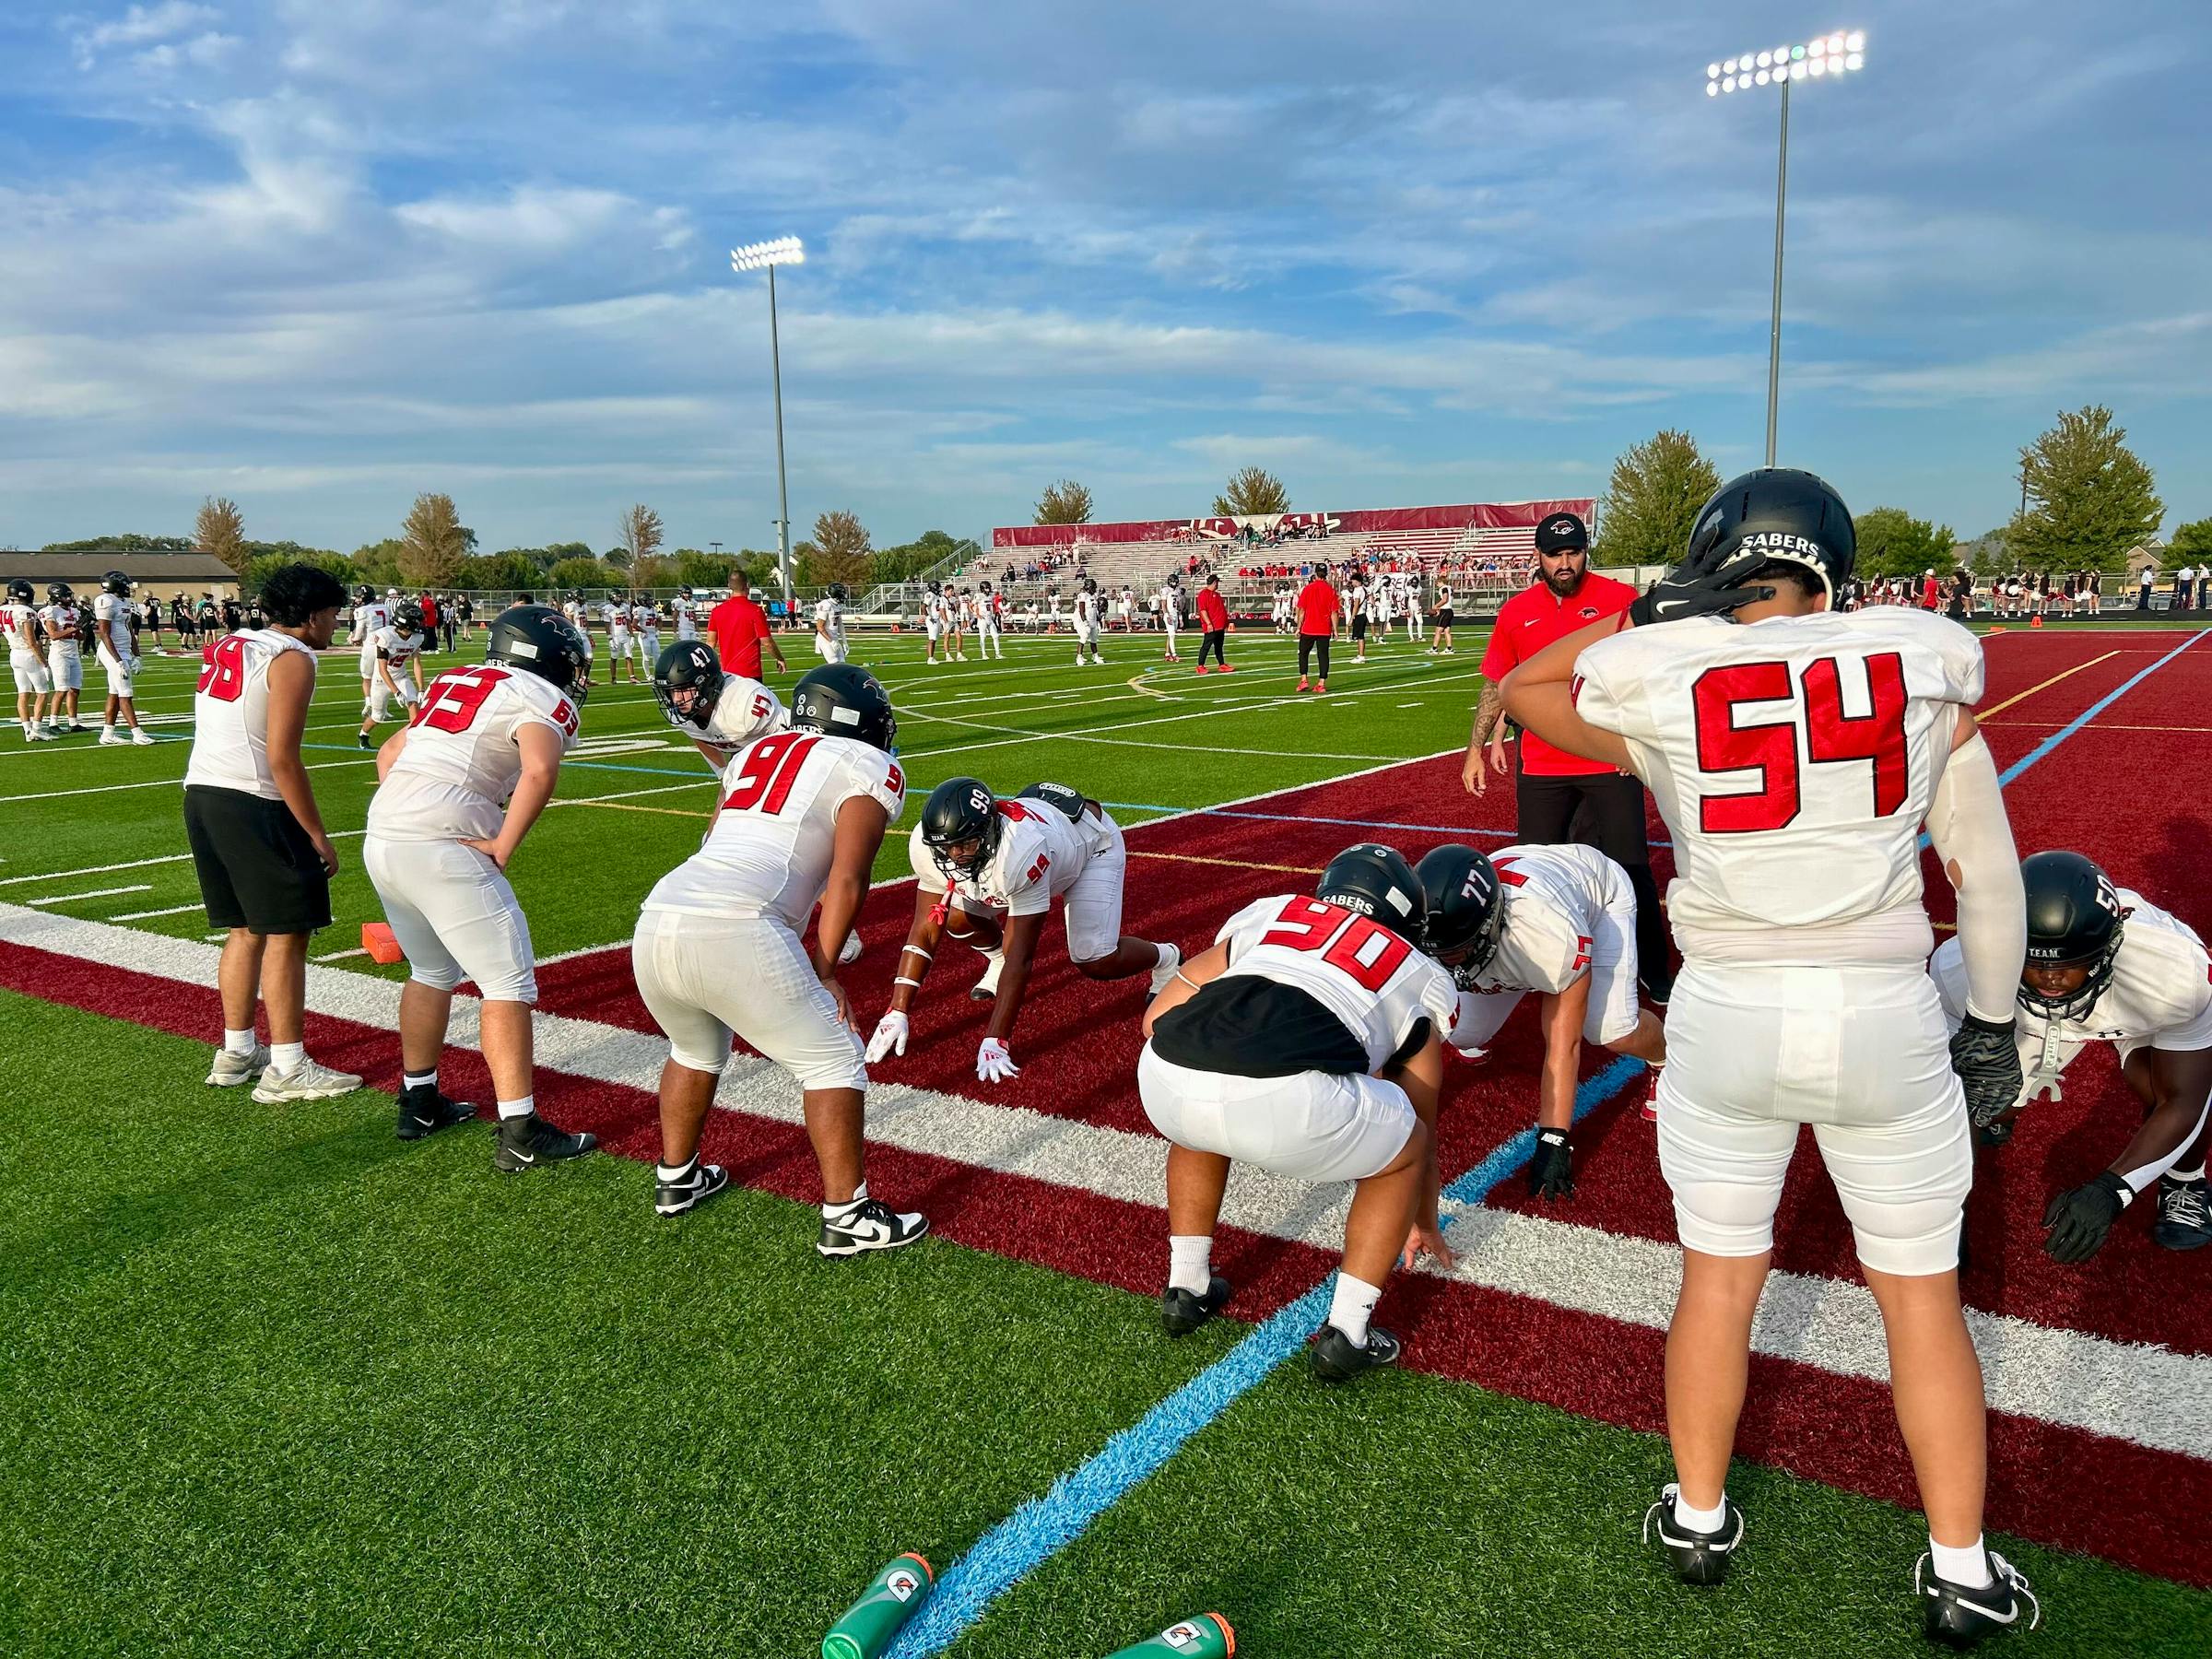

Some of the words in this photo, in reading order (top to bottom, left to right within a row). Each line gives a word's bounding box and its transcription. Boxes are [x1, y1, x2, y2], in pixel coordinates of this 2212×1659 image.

[1742, 533, 1819, 557] SABERS
[375, 610, 386, 627] 7
[690, 647, 711, 668] 47
[550, 699, 579, 737] 63
[751, 694, 772, 719] 47
[1691, 651, 1909, 834] 54
[722, 733, 825, 816] 91
[884, 763, 904, 802] 91
[970, 788, 991, 815] 99
[1027, 853, 1051, 886] 99
[1461, 868, 1492, 908] 77
[1322, 894, 1374, 915] SABERS
[1259, 894, 1414, 994] 90
[1540, 1132, 1565, 1147] NIKE
